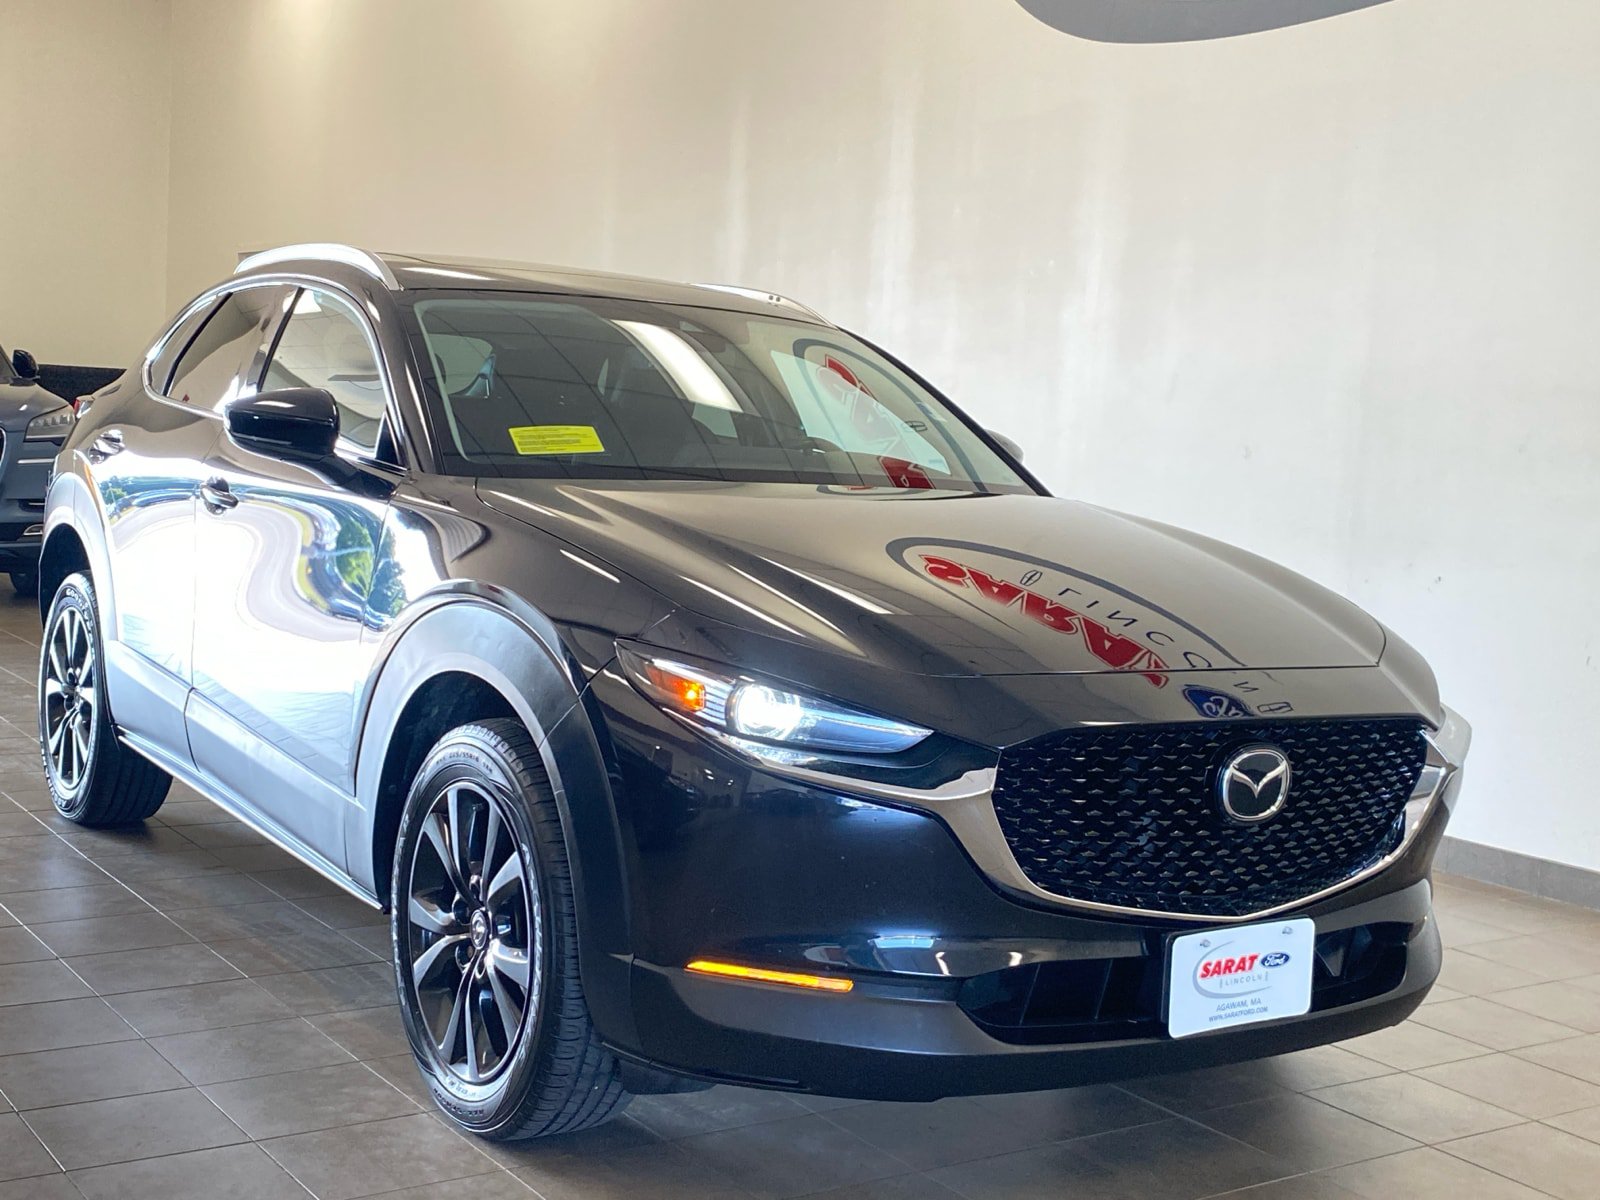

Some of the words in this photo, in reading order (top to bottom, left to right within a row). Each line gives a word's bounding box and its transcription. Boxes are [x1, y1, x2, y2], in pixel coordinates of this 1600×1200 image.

[1200, 954, 1259, 978] SARAT
[1263, 953, 1288, 967] Ford
[1225, 974, 1263, 986] LINCOLN
[1216, 999, 1248, 1012] AGAWAM,
[1250, 997, 1262, 1006] MA
